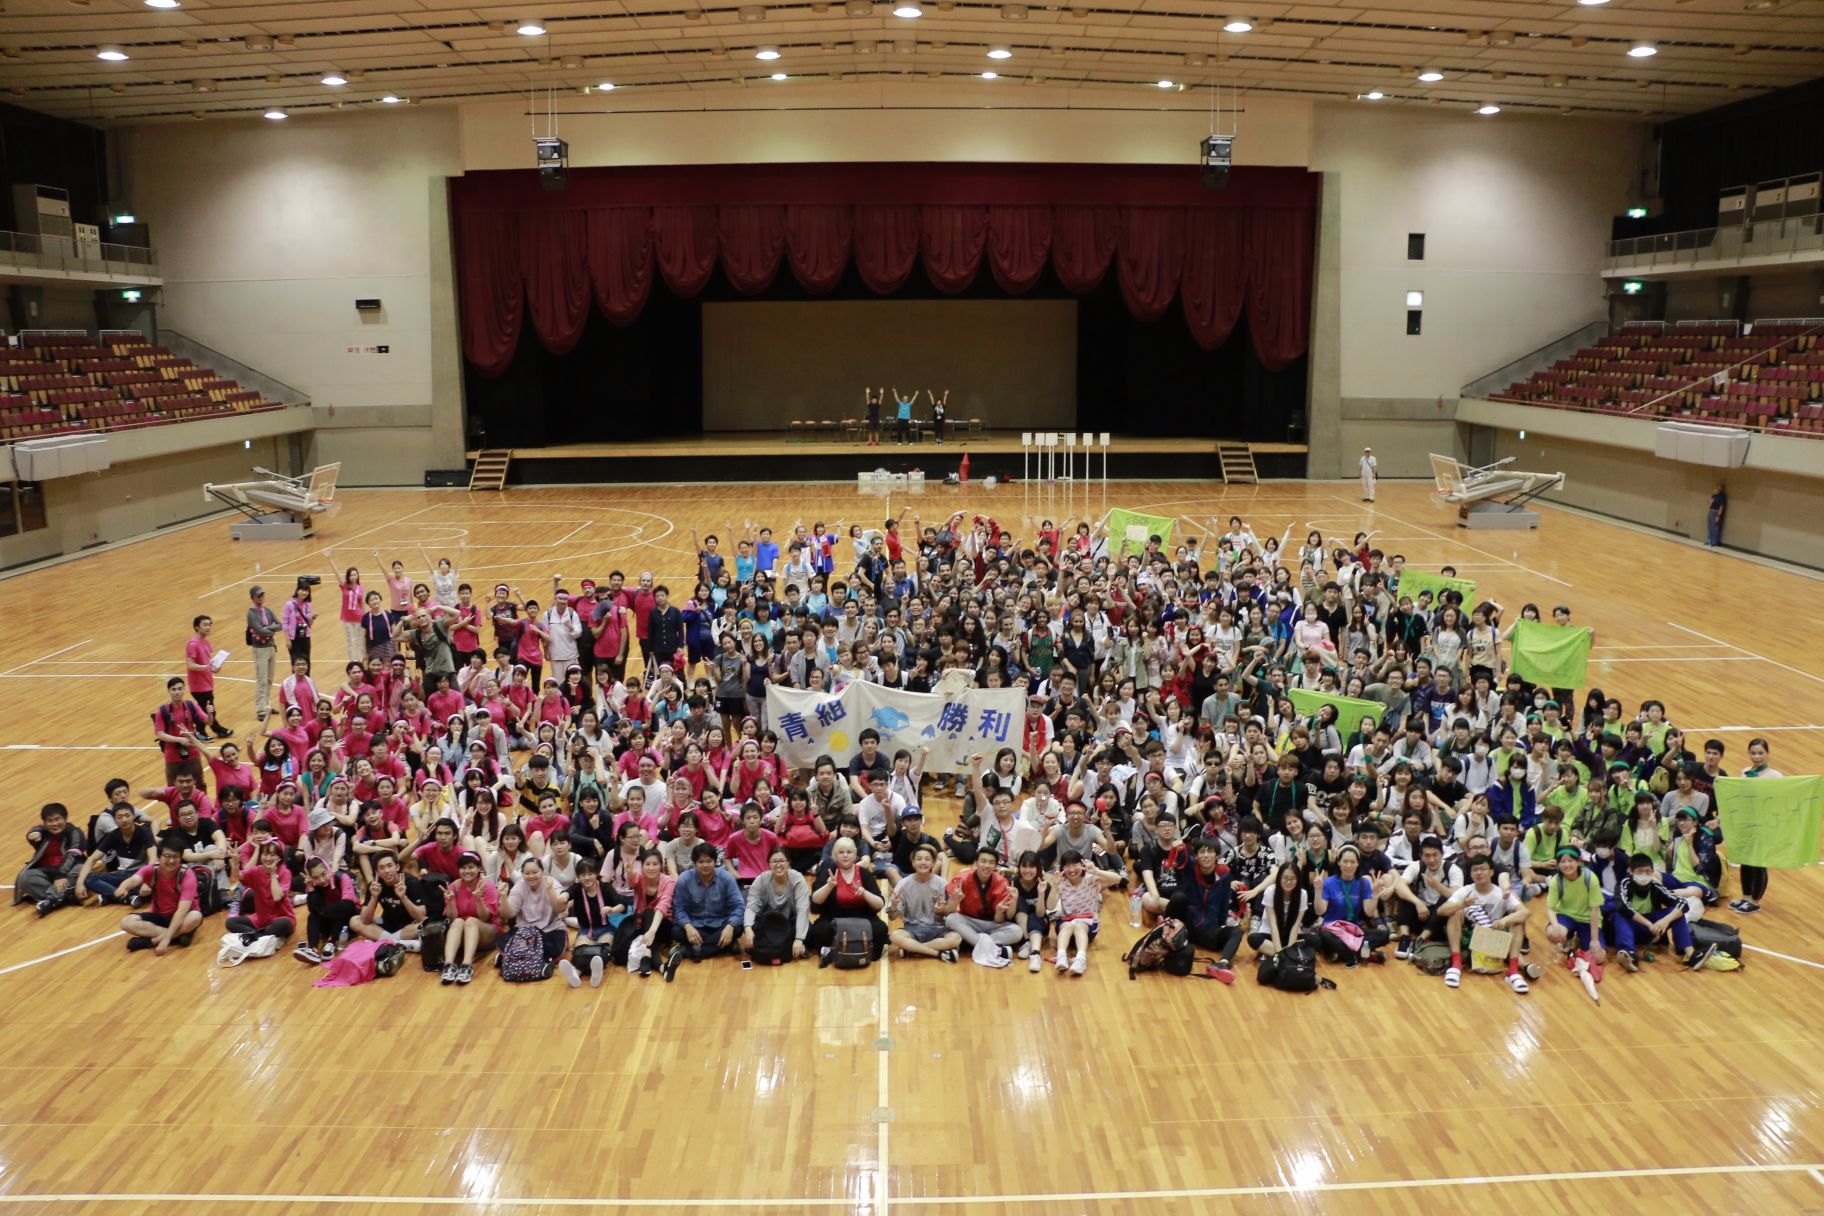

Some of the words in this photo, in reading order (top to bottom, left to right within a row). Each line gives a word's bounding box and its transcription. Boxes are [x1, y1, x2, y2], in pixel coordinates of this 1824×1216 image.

[778, 699, 847, 742] 青組
[937, 702, 1011, 742] 勝利
[1726, 794, 1820, 831] FIGHT
